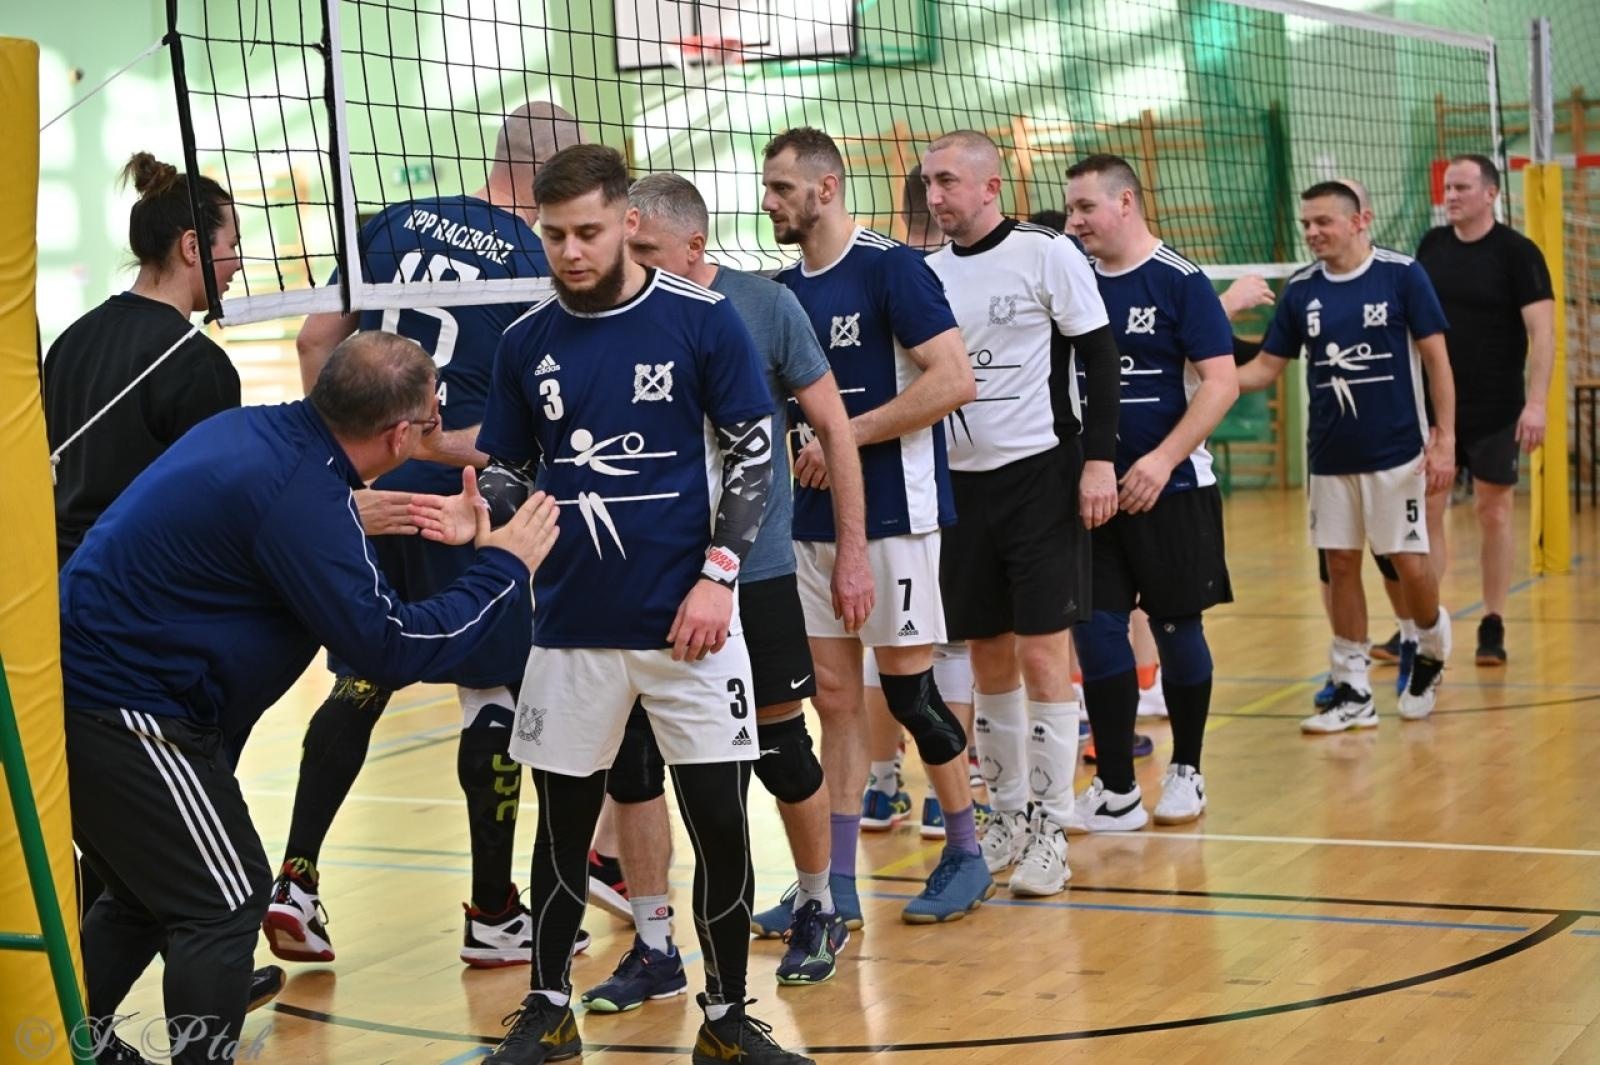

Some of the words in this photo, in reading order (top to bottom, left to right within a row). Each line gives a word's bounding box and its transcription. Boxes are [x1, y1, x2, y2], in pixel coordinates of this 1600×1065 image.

[403, 209, 438, 234] KPP
[432, 218, 514, 265] RACIBÓRZ
[1307, 311, 1321, 337] 5
[539, 378, 564, 421] 3
[1406, 499, 1419, 523] 5
[898, 578, 912, 611] 7
[727, 678, 748, 720] 3
